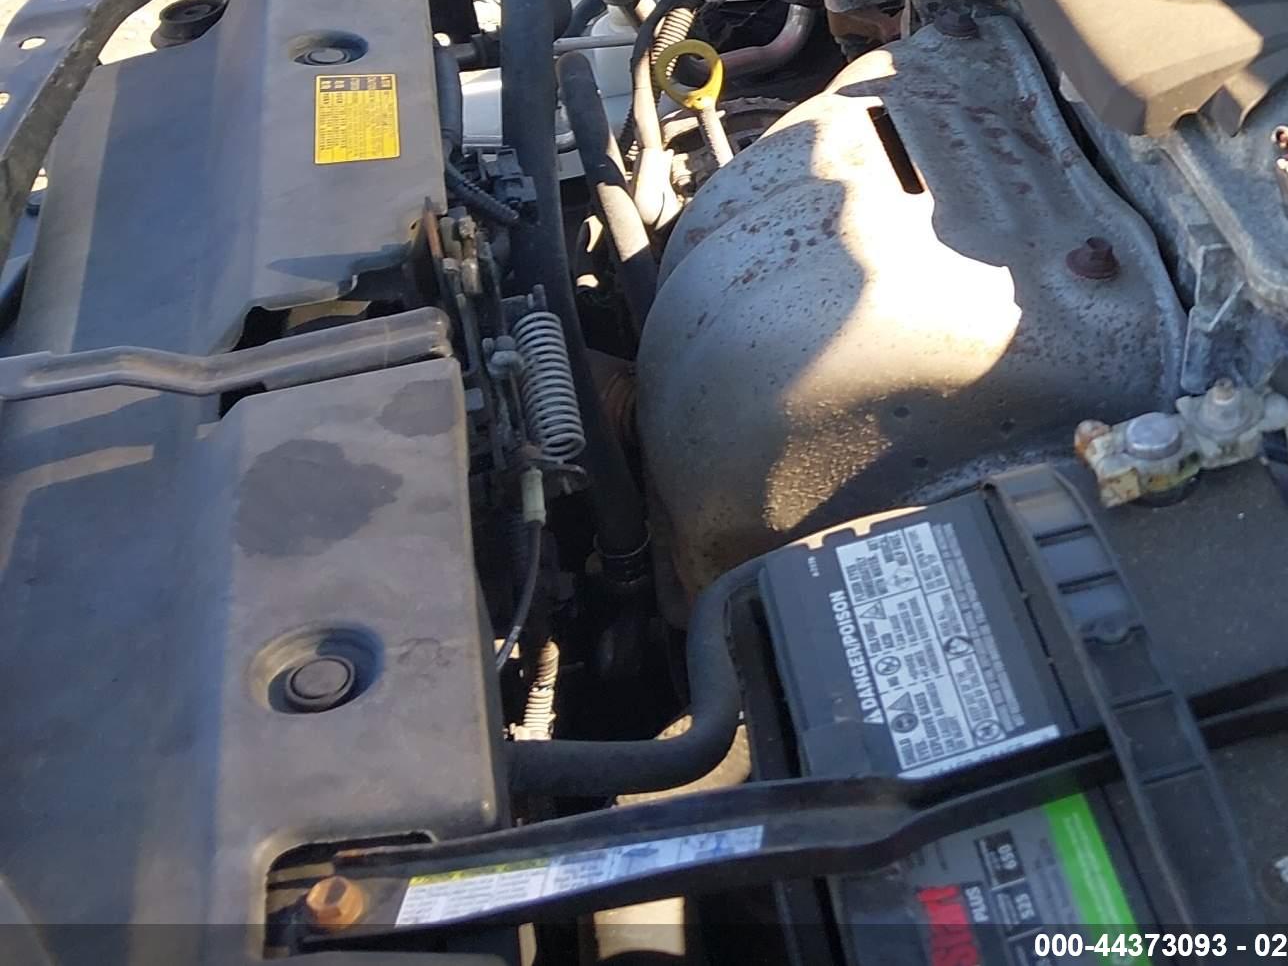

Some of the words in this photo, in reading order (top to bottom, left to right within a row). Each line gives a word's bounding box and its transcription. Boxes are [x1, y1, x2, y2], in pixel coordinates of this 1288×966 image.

[827, 588, 879, 711] DANGER/POISON
[998, 843, 1018, 870] 650
[965, 886, 990, 923] PLUS
